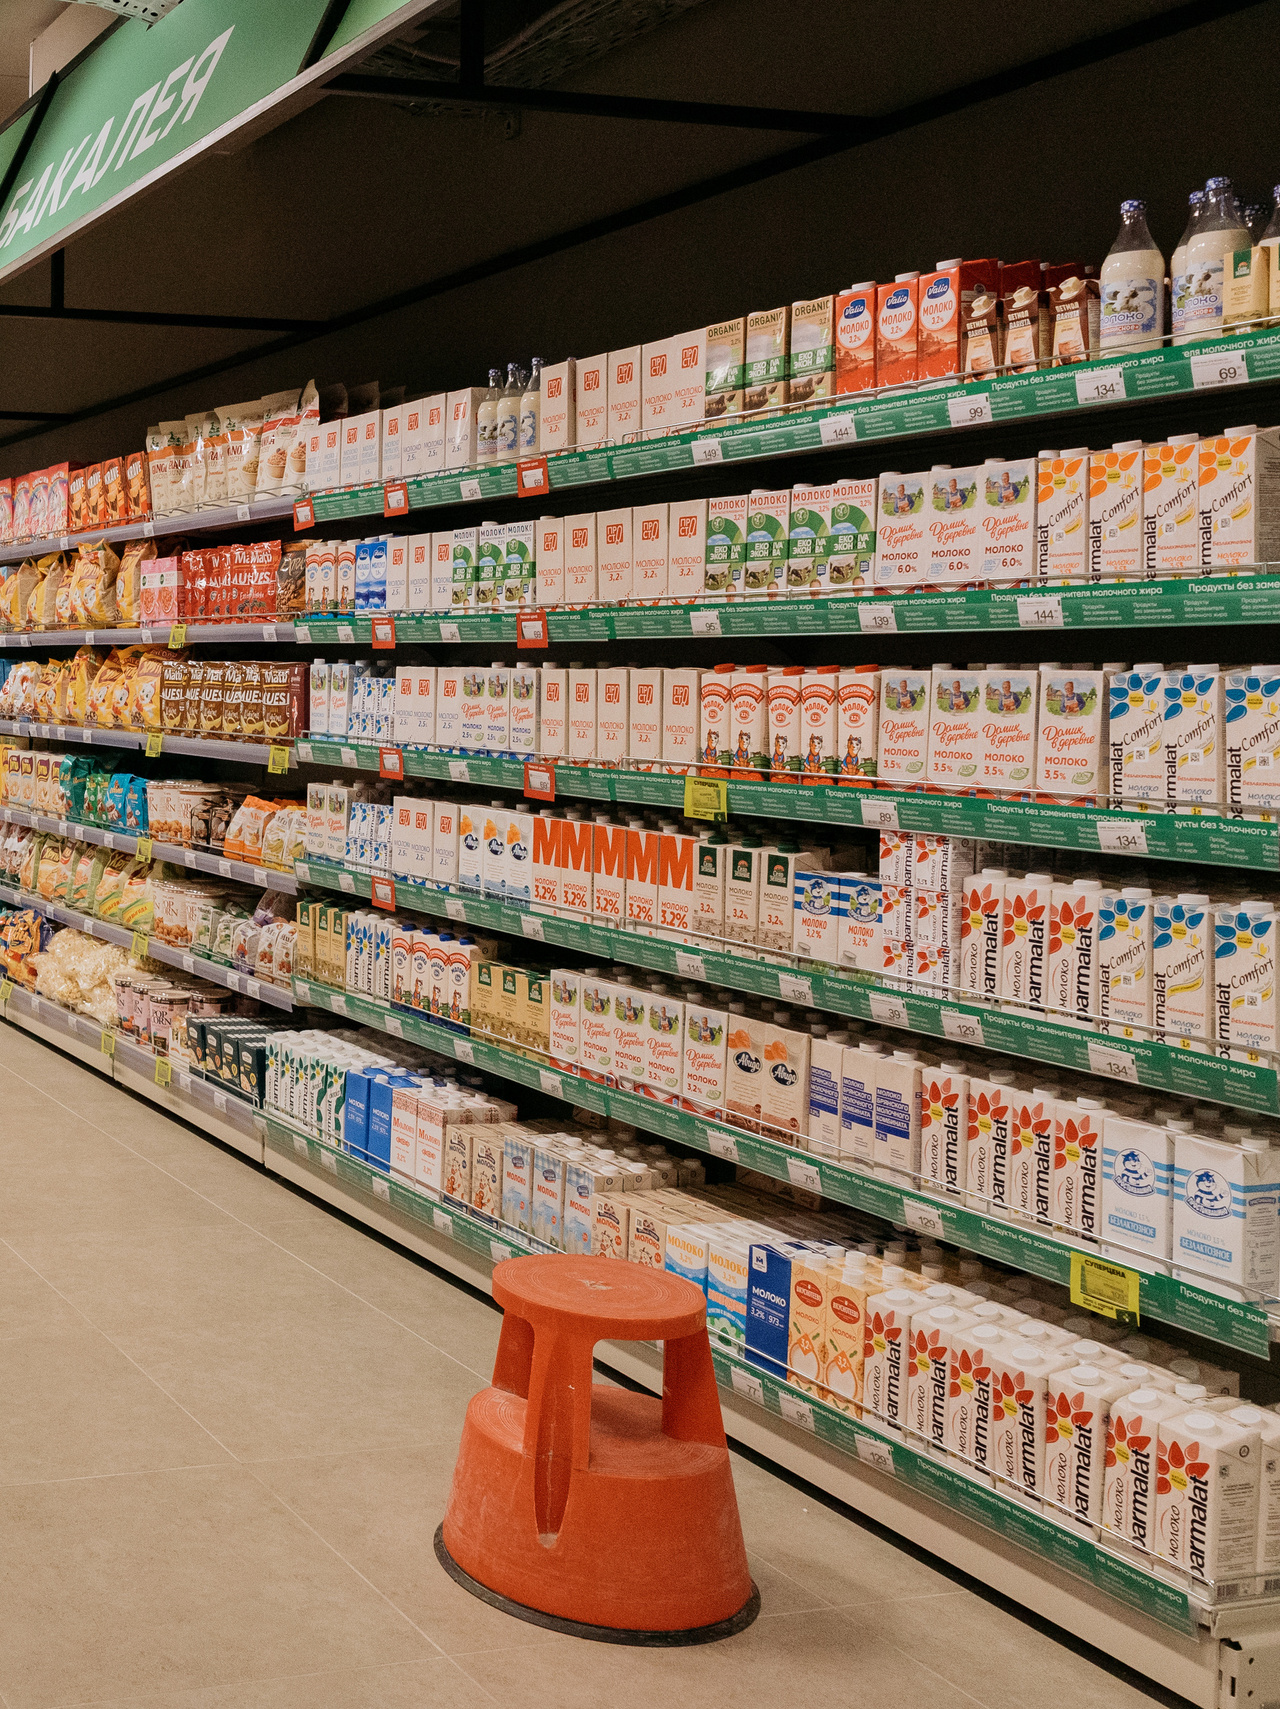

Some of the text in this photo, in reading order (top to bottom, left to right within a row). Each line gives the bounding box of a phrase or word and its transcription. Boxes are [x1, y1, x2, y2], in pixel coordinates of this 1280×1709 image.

[928, 284, 950, 296] Valio
[887, 296, 908, 306] Valio
[923, 300, 953, 314] МОЛОКО
[794, 300, 830, 317] ORGANIC
[844, 304, 866, 316] Valio
[749, 312, 783, 328] ORGANIC
[882, 311, 912, 325] МОЛОКО
[708, 322, 741, 338] ORGANIC
[840, 320, 870, 334] МОЛОКО
[1219, 367, 1237, 380] 69
[675, 385, 703, 397] МОЛОКО
[1094, 384, 1115, 396] 134
[645, 393, 672, 405] МОЛОКО
[579, 406, 604, 417] МОЛОКО
[611, 400, 638, 411] МОЛОКО
[970, 408, 983, 418] 99
[833, 429, 850, 438] 144
[793, 490, 831, 502] МОЛОКО
[833, 483, 873, 497] МОЛОКО
[1212, 473, 1253, 512] Comfort
[711, 499, 745, 511] МОЛОКО
[1102, 487, 1140, 523] Comfort
[1157, 480, 1197, 518] Comfort
[1049, 492, 1084, 527] Comfort
[879, 523, 914, 539] Домик
[929, 519, 967, 535] Домик
[1144, 513, 1157, 583] armalat
[1200, 508, 1212, 580] armalat
[881, 551, 918, 561] МОЛОКО
[931, 549, 971, 558] МОЛОКО
[1038, 523, 1049, 590] armalat
[1090, 519, 1102, 586] armalat
[1162, 554, 1192, 563] МОЛОКО
[1217, 551, 1249, 559] МОЛОКО
[601, 562, 630, 571] МОЛОКО
[636, 559, 665, 568] МОЛОКО
[671, 556, 702, 565] МОЛОКО
[949, 561, 969, 571] 6,0%
[898, 564, 917, 574] 6,0%
[1092, 586, 1163, 597] молочного жира
[1189, 583, 1235, 593] Продукты
[872, 617, 889, 625] 139
[1034, 610, 1054, 620] 144
[632, 723, 657, 731] МОЛОКО
[666, 726, 694, 734] МОЛОКО
[933, 721, 969, 737] Домик
[983, 723, 1020, 739] Домик
[1043, 725, 1084, 741] Домик
[1124, 713, 1163, 746] Comfort
[1177, 714, 1216, 748] Comfort
[884, 748, 919, 757] МОЛОКО
[934, 751, 973, 760] МОЛОКО
[984, 753, 1024, 763] МОЛОКО
[934, 762, 953, 772] 3,5%
[1045, 756, 1088, 767] МОЛОКО
[984, 766, 1004, 776] 3,5%
[1044, 769, 1066, 781] 3,5%
[880, 812, 891, 822] 89
[1116, 835, 1137, 846] 134
[905, 835, 914, 887] parmalat
[941, 839, 949, 892] parmalat
[535, 878, 557, 887] МОЛОКО
[564, 882, 587, 893] МОЛОКО
[535, 886, 557, 902] 3,2%
[563, 890, 587, 908] 3,2%
[596, 888, 620, 899] МОЛОКО
[595, 897, 620, 915] 3,2%
[629, 895, 653, 906] МОЛОКО
[629, 903, 653, 922] 3,2%
[662, 901, 688, 913] МОЛОКО
[661, 910, 688, 929] 3,2%
[802, 917, 827, 929] МОЛОКО
[848, 924, 874, 938] МОЛОКО
[1110, 941, 1147, 969] Comfort
[1166, 949, 1205, 978] Comfort
[1231, 958, 1274, 989] Comfort
[792, 989, 807, 1000] 139
[889, 1009, 900, 1019] 39
[957, 1025, 975, 1036] 129
[649, 1060, 675, 1074] МОЛОКО
[1107, 1062, 1127, 1075] 134
[687, 1072, 717, 1087] МОЛОКО
[877, 1089, 901, 1100] МОЛОКО
[804, 1173, 815, 1184] 79
[919, 1216, 935, 1229] 129
[1109, 1215, 1156, 1238] БЕЗЛАКТОЗНОЕ
[668, 1233, 704, 1259] МОЛОКО
[1180, 1237, 1231, 1261] БЕЗЛАКТОЗНОЕ
[710, 1252, 748, 1277] МОЛОКО
[1085, 1259, 1126, 1278] СУПЕРЦЕНА
[752, 1286, 787, 1308] МОЛОКО
[1180, 1286, 1226, 1310] Продукты
[747, 1384, 756, 1395] 77
[870, 1451, 886, 1465] 129
